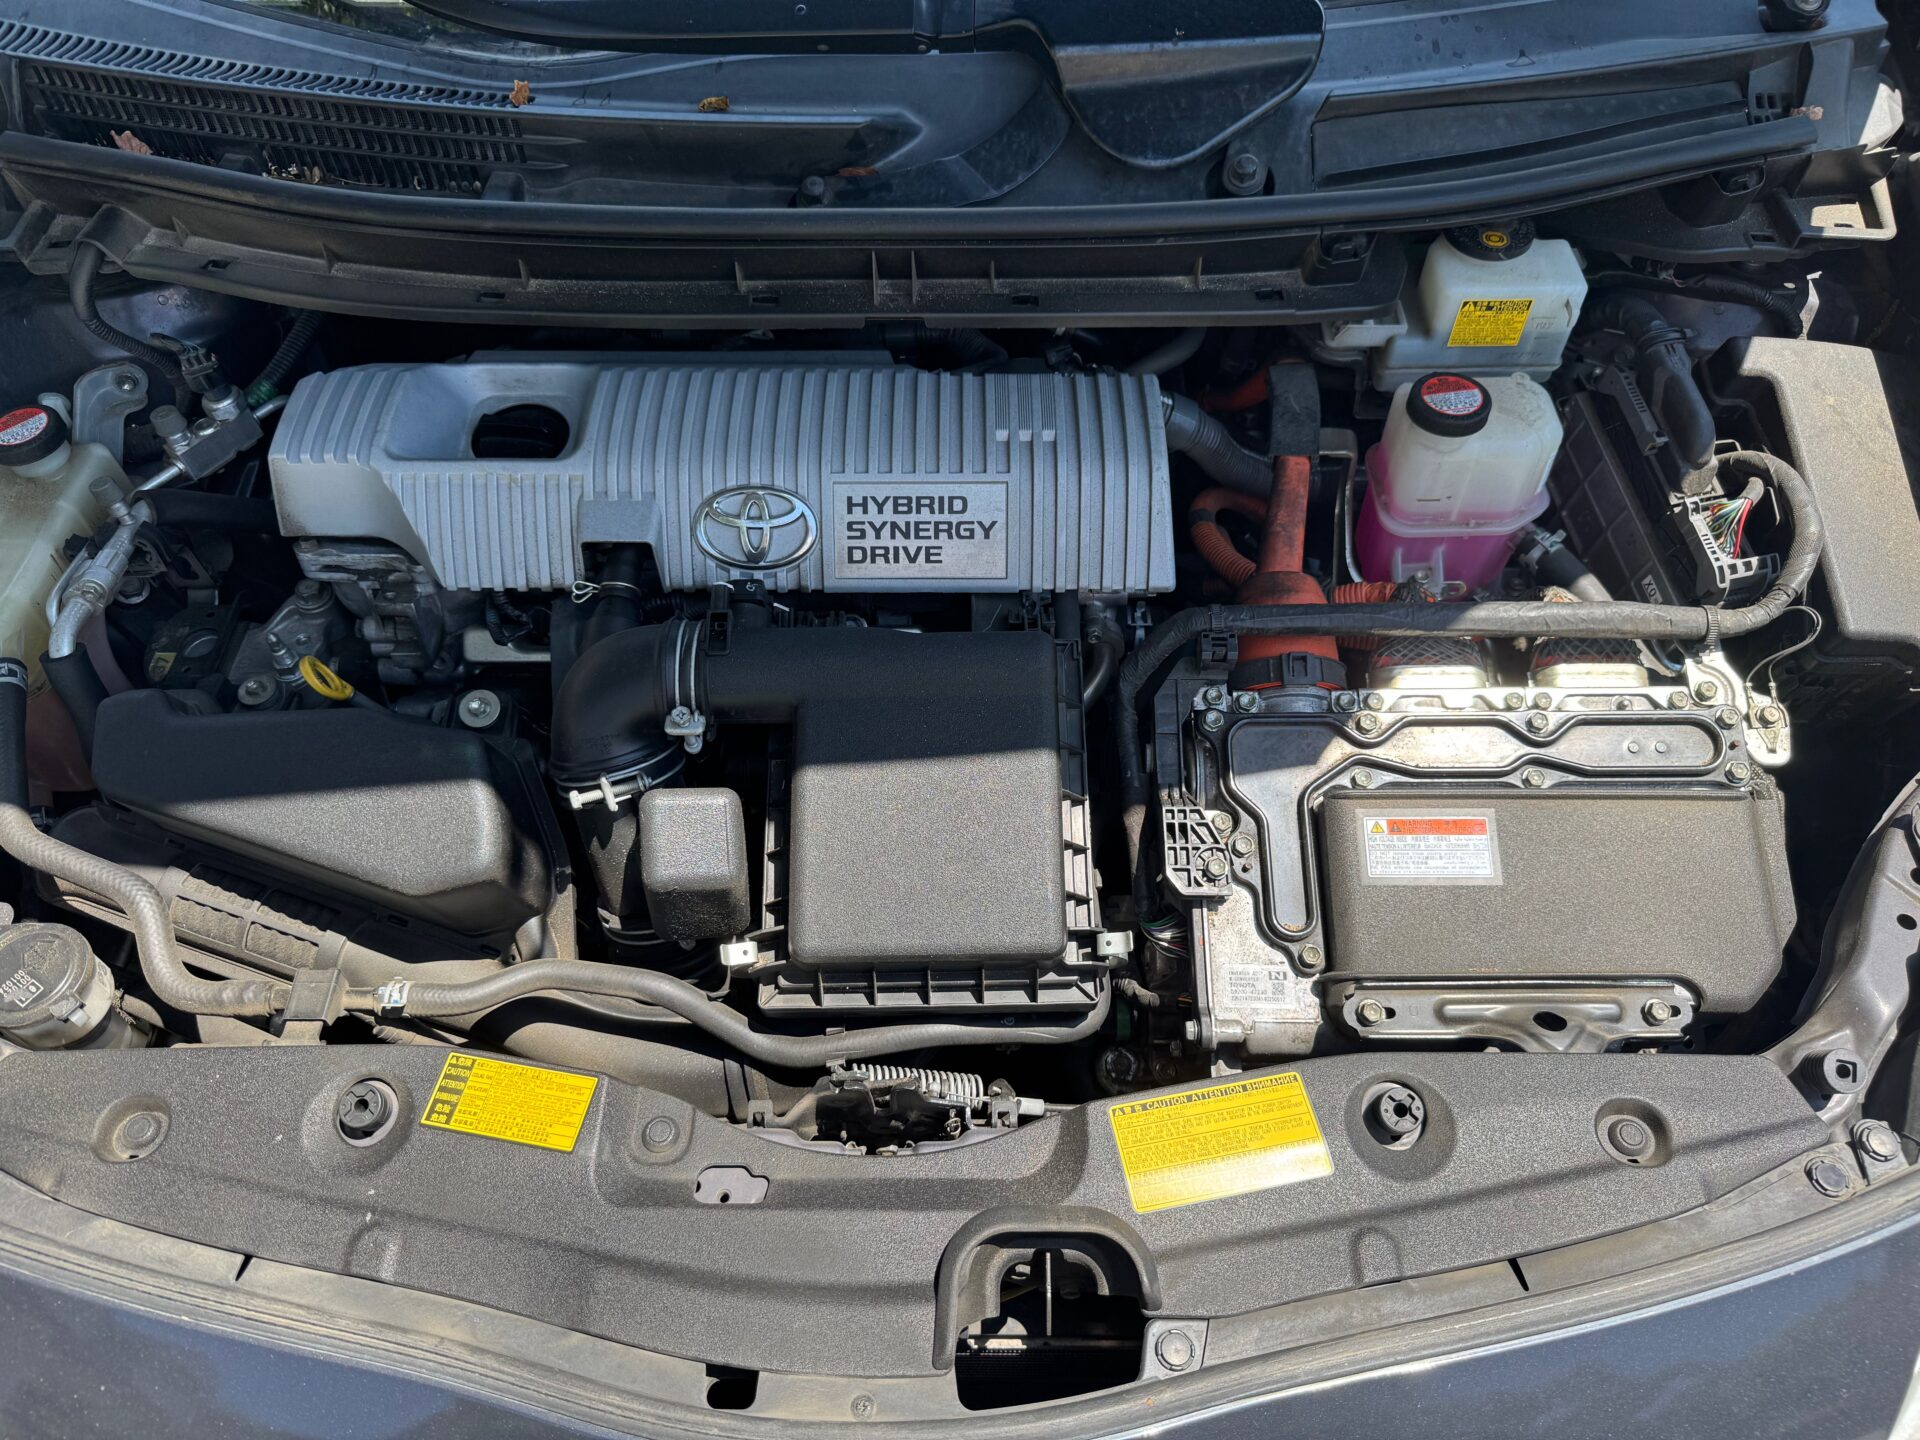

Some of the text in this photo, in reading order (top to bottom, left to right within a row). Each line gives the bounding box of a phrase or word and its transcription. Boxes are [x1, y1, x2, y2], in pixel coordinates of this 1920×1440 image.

[846, 495, 969, 515] HYBRID
[846, 520, 999, 540] SYNERGY
[846, 545, 943, 564] DRIVE
[446, 1066, 471, 1077] CAUTION
[440, 1079, 466, 1090] ATTENTION
[1146, 1095, 1188, 1110] CAUTION
[1191, 1085, 1244, 1102] ATTENTION
[1246, 1074, 1295, 1091] ВНИМАНИЕ
